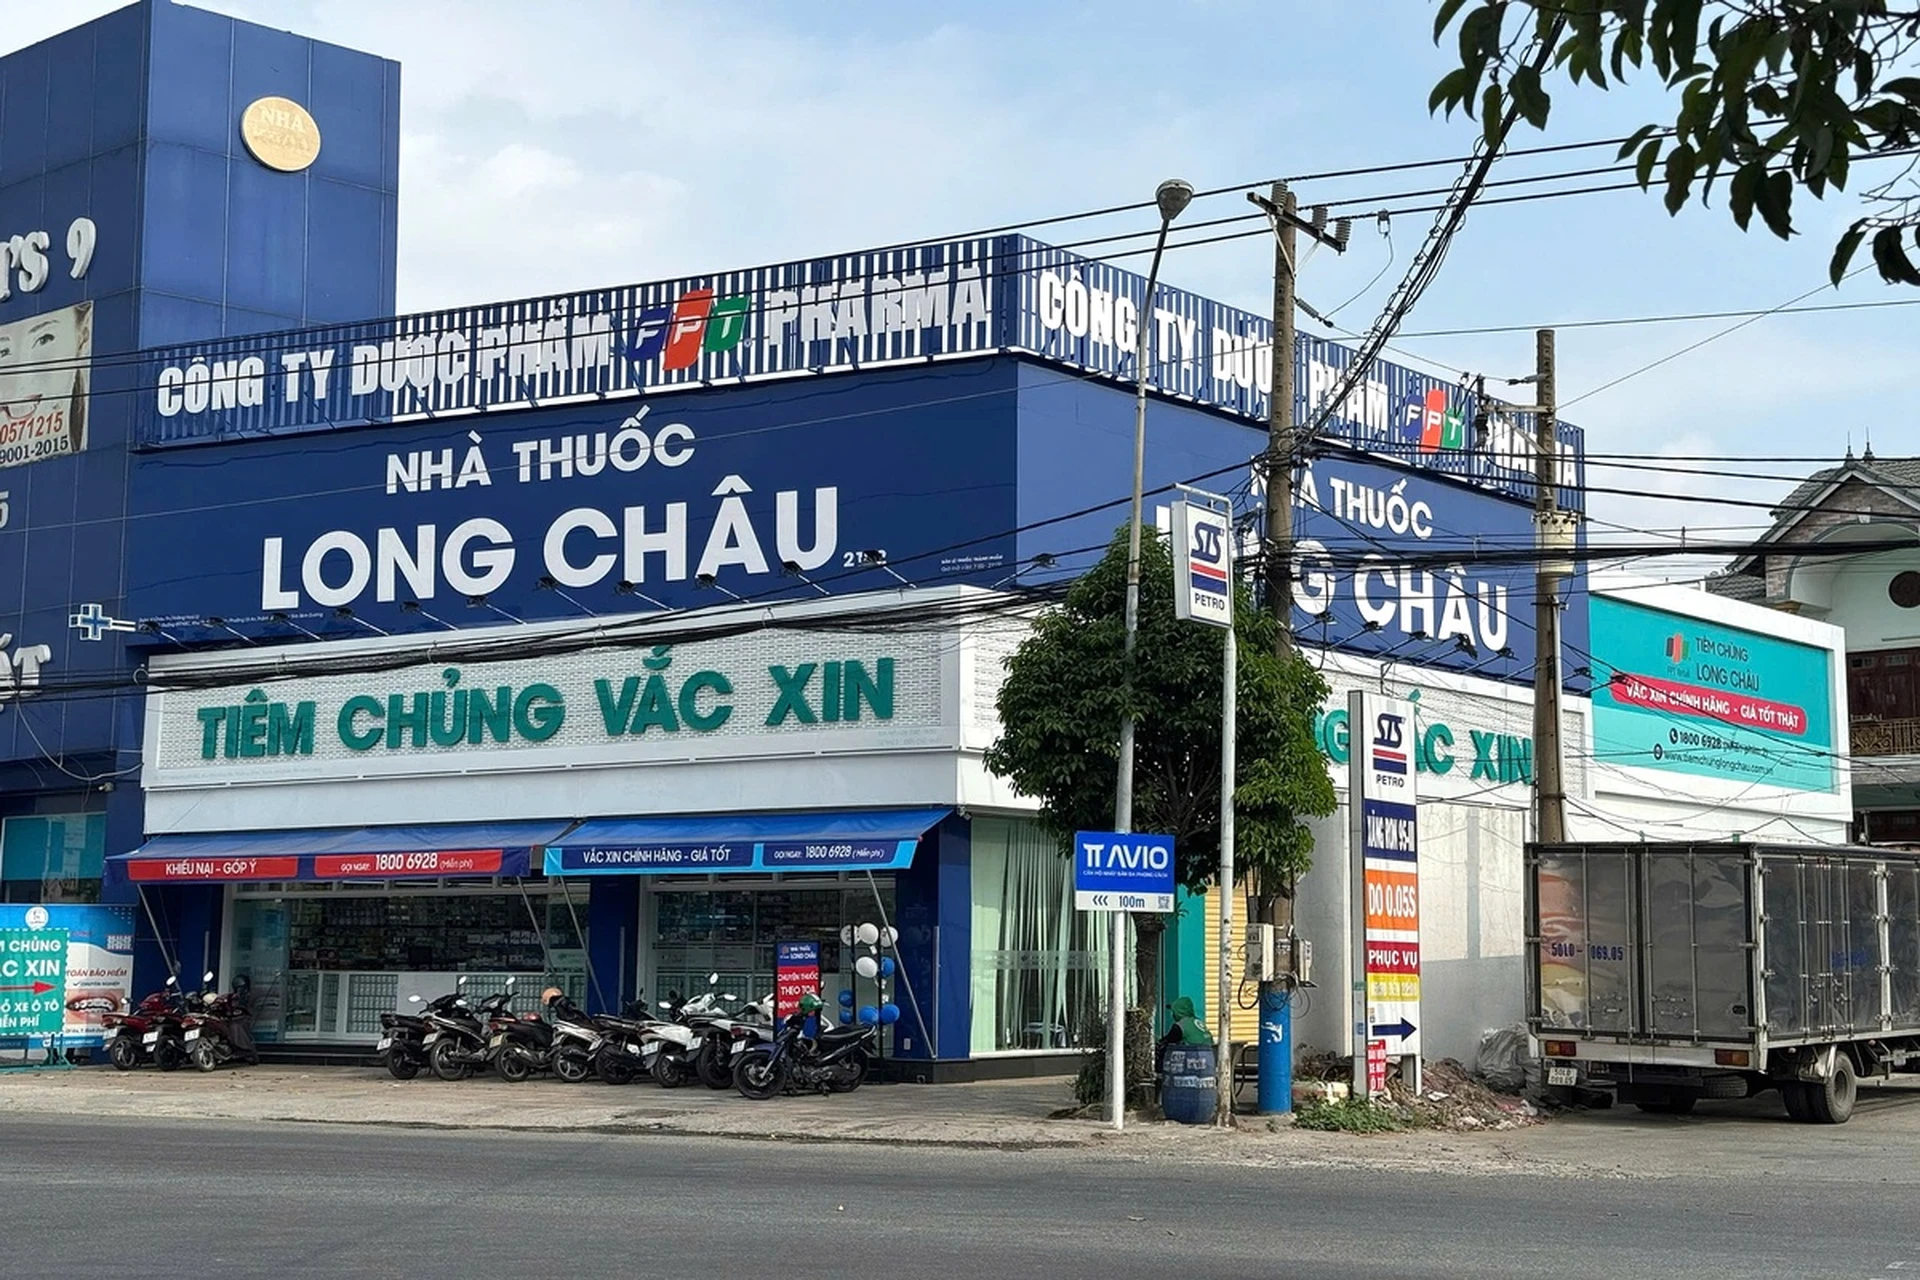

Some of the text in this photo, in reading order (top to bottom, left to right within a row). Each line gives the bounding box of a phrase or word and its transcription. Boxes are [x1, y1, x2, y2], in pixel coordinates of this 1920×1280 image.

[66, 217, 97, 279] 9
[768, 266, 988, 346] PHARMA
[1039, 269, 1138, 354] CÔNG
[1154, 307, 1196, 371] TY
[157, 298, 611, 417] CÔNG TY DƯỢC PHẨM
[386, 404, 696, 494] NHÀ THUỐC
[1330, 478, 1433, 539] THUỐC
[262, 474, 838, 610] LONG CHÂU
[1194, 593, 1225, 611] PETRO
[1696, 663, 1760, 692] LONG CHÂU
[197, 645, 895, 759] TIÊM CHỦNG VẮC XIN
[1740, 704, 1757, 720] GIÁ
[1680, 731, 1700, 747] 1800
[1469, 729, 1535, 786] XIN
[1376, 774, 1405, 788] PETRO
[375, 853, 403, 871] 1800
[405, 851, 438, 871] 6928
[605, 850, 621, 863] XIN
[622, 847, 652, 863] CHÍNH
[653, 847, 682, 862] HÃNG
[690, 846, 708, 862] GIÁ
[710, 844, 731, 862] TỐT
[805, 846, 827, 858] 1800
[828, 845, 852, 858] 6928
[165, 858, 195, 875] KHIẾU
[195, 861, 214, 878] NẠI
[223, 858, 248, 875] GÓP
[248, 858, 257, 873] Ý
[1119, 896, 1145, 908] 100m
[9, 935, 61, 952] CHỦNG
[24, 959, 60, 976] XIN
[1368, 948, 1418, 969] PHỤC VỤ
[780, 985, 801, 996] THEO
[14, 1002, 29, 1012] XE
[31, 1000, 41, 1012] Ô
[44, 999, 59, 1012] TÔ
[20, 1014, 40, 1027] PHÍ
